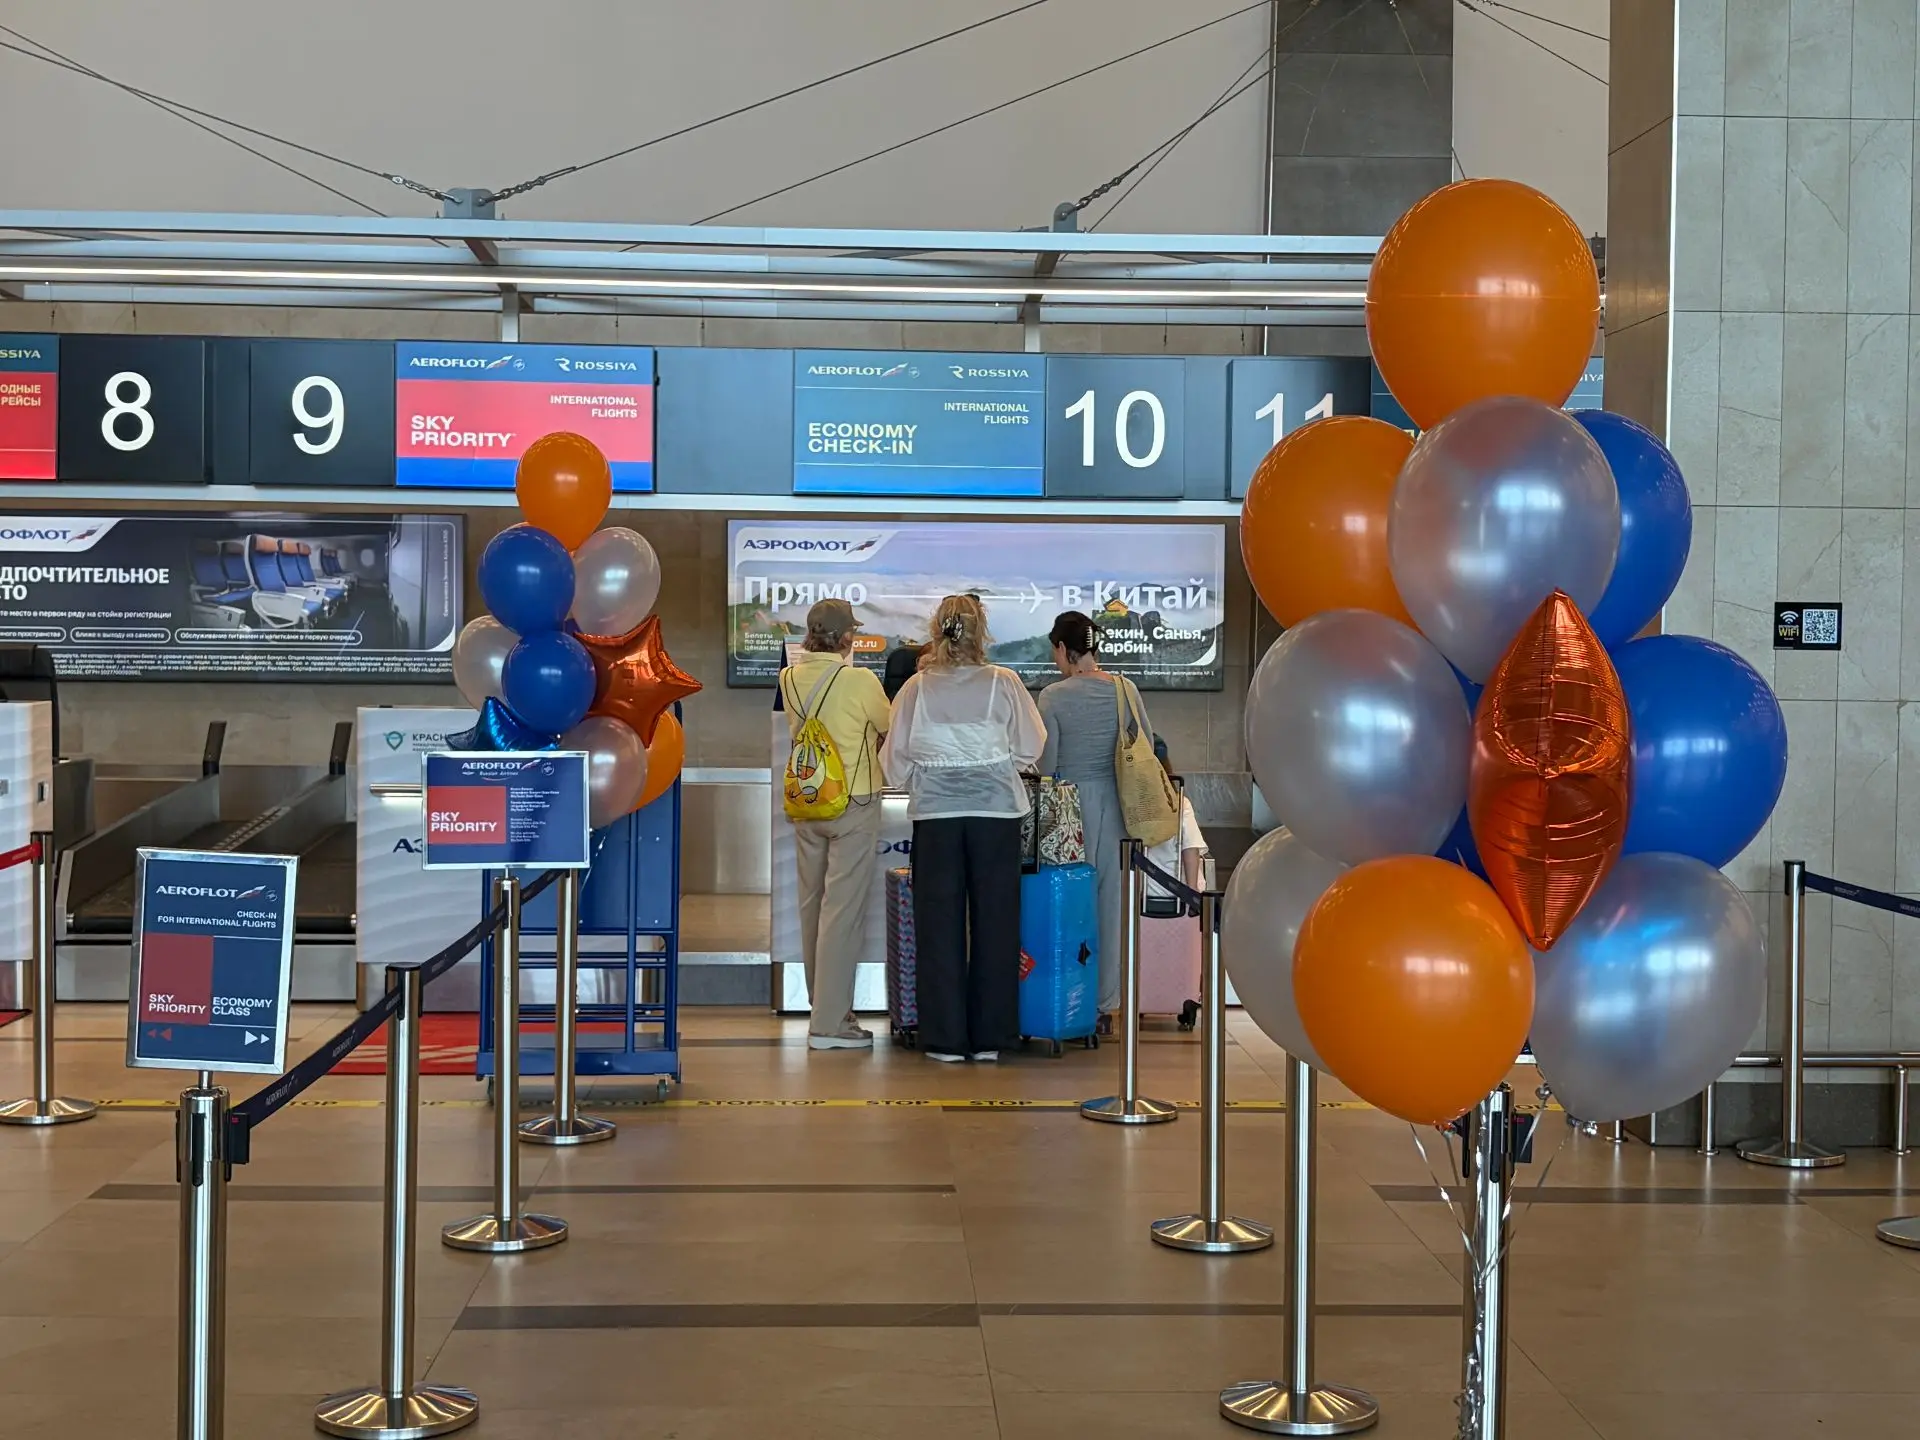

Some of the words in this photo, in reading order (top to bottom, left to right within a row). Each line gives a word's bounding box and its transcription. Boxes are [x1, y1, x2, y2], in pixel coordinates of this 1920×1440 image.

[410, 357, 487, 368] AEROFLOT
[575, 361, 637, 371] ROSSIYA
[808, 366, 883, 376] AEROFLOT
[968, 368, 1029, 378] ROSSIYA
[0, 384, 41, 394] ОДНЫЕ
[1, 395, 41, 406] РЕЙСЫ
[550, 395, 637, 406] INTERNATIONAL
[101, 371, 155, 451] 8
[944, 402, 1029, 413] INTERNATIONAL
[291, 375, 345, 455] 9
[591, 408, 637, 419] FLIGHTS
[411, 415, 454, 431] SKY
[984, 415, 1029, 425] FLIGHTS
[808, 422, 918, 438] ECONOMY
[1065, 389, 1166, 468] 10
[411, 431, 511, 448] PRIORITY
[808, 438, 913, 455] CHECK-IN
[0, 529, 71, 540] ОФЛОТ
[743, 539, 851, 550] АЭРОФЛОТ
[0, 566, 170, 585] ДПОЧТИТЕЛЬНОЕ
[0, 584, 28, 601] ТО
[744, 576, 868, 612] Прямо
[1062, 585, 1082, 608] в
[1093, 577, 1207, 610] Китай
[68, 611, 86, 619] ряду
[1152, 626, 1206, 642] Санья,
[462, 762, 522, 770] AEROFLOT
[431, 811, 460, 822] SKY
[431, 821, 497, 832] PRIORITY
[156, 885, 238, 898] AEROFLOT
[237, 910, 276, 919] CHECK-IN
[158, 915, 174, 923] FOR
[176, 916, 241, 927] INTERNATIONAL
[242, 920, 276, 928] FLIGHTS
[149, 993, 174, 1003] SKY
[212, 996, 272, 1008] ECONOMY
[148, 1003, 206, 1014] PRIORITY
[212, 1006, 250, 1016] CLASS
